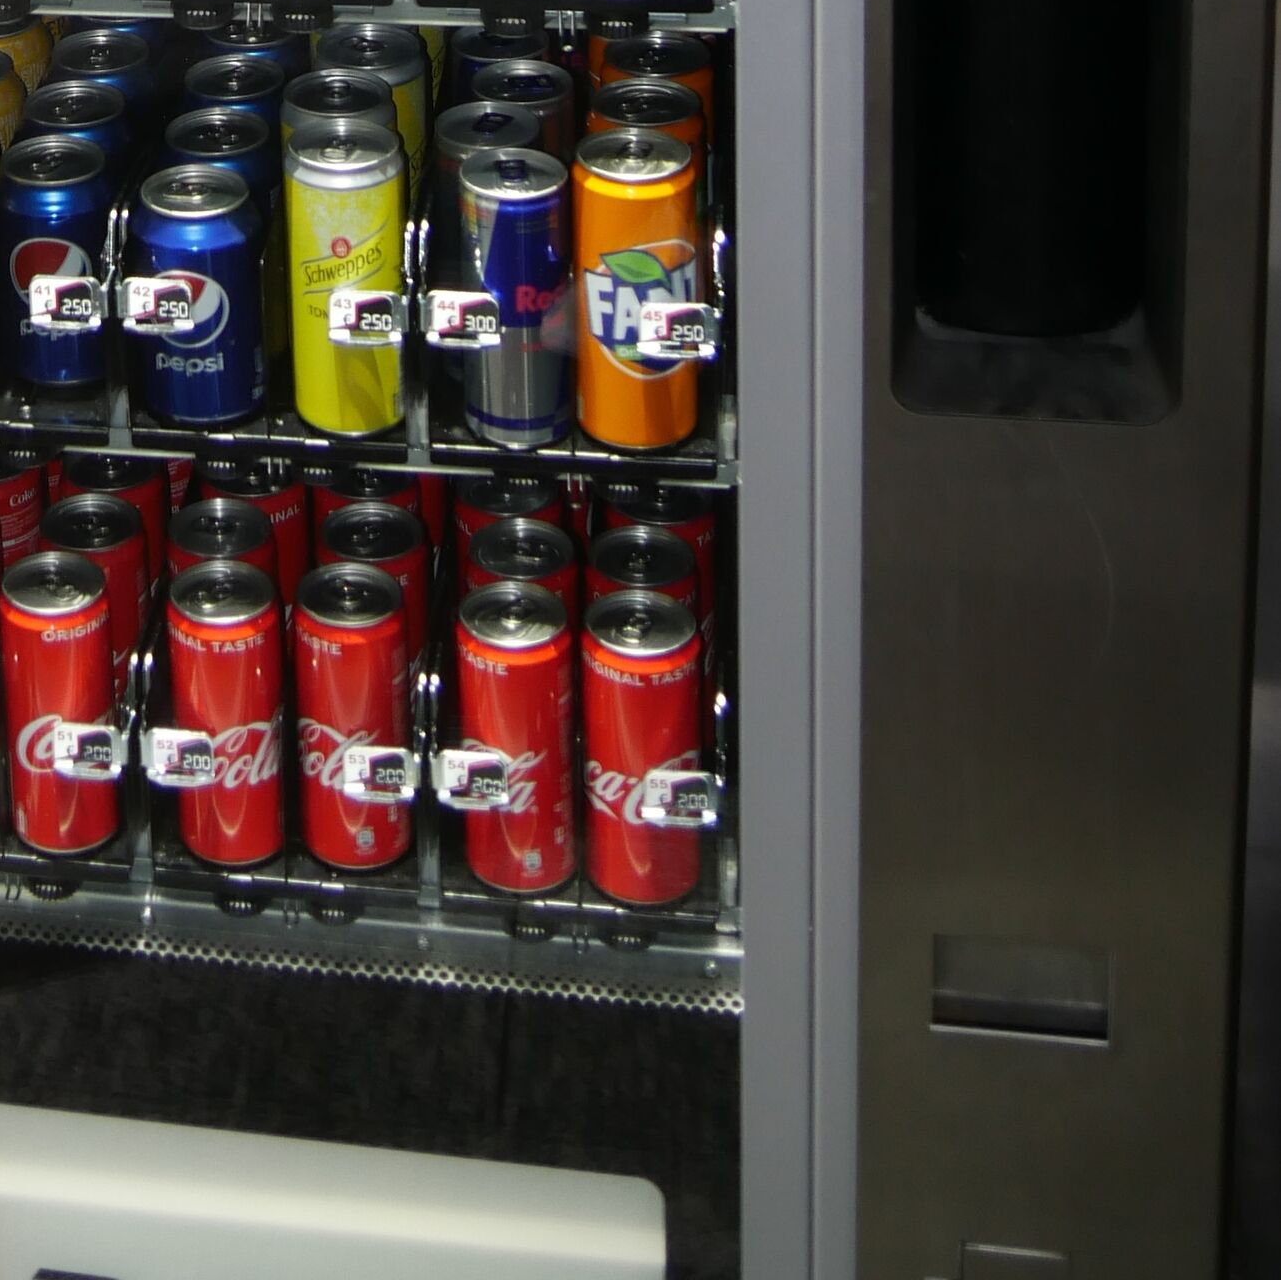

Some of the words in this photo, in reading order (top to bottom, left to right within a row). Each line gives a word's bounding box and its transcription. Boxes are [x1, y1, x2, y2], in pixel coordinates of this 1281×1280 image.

[304, 242, 383, 286] Schweppes
[34, 285, 51, 295] 41
[133, 286, 150, 296] 42
[333, 299, 351, 309] 43
[437, 300, 455, 310] 44
[308, 305, 328, 318] TON
[643, 311, 662, 321] 45
[156, 352, 224, 377] pepsi
[212, 633, 265, 654] TASTE
[57, 730, 73, 740] 51
[156, 740, 174, 750] 52
[348, 754, 366, 764] 53
[448, 760, 465, 770] 54
[650, 779, 668, 789] 55
